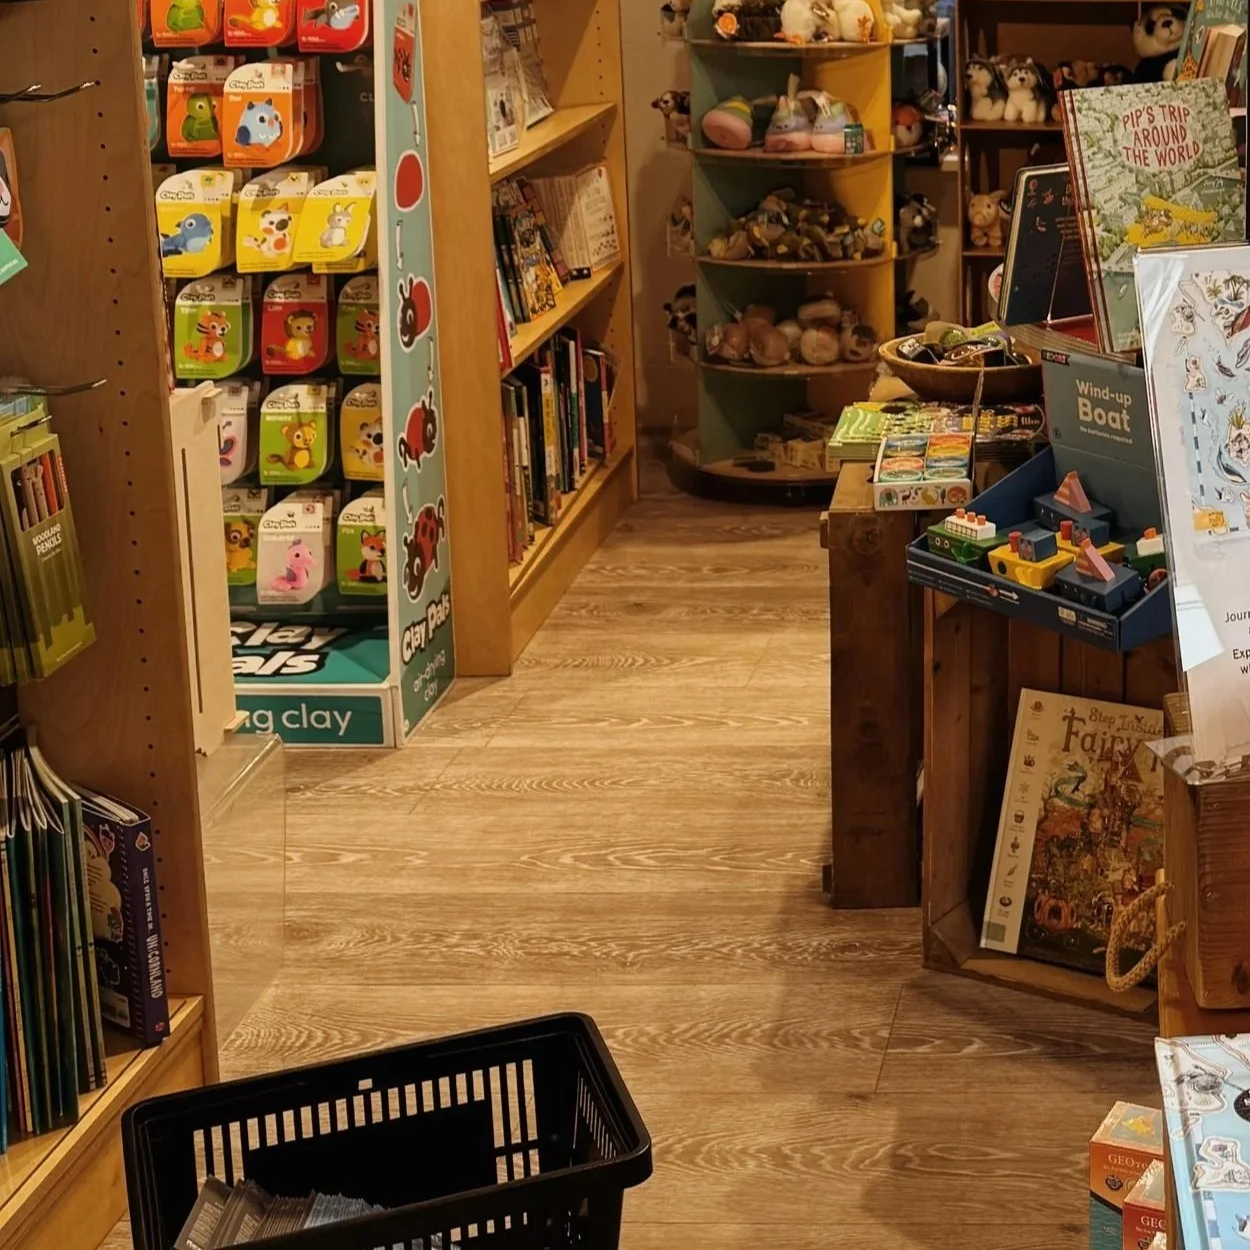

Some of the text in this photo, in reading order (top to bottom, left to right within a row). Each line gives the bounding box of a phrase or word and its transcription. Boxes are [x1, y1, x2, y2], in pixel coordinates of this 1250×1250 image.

[1122, 104, 1190, 132] PIP'S TRIP
[1133, 124, 1187, 148] AROUND
[1122, 141, 1200, 167] THE WORLD
[1076, 379, 1132, 406] Wind-up
[1077, 396, 1132, 432] Boat
[402, 592, 450, 664] Clay Pals
[230, 651, 322, 675] als
[282, 703, 353, 736] clay
[1062, 707, 1145, 753] Fairy
[1088, 707, 1163, 737] Step Inside
